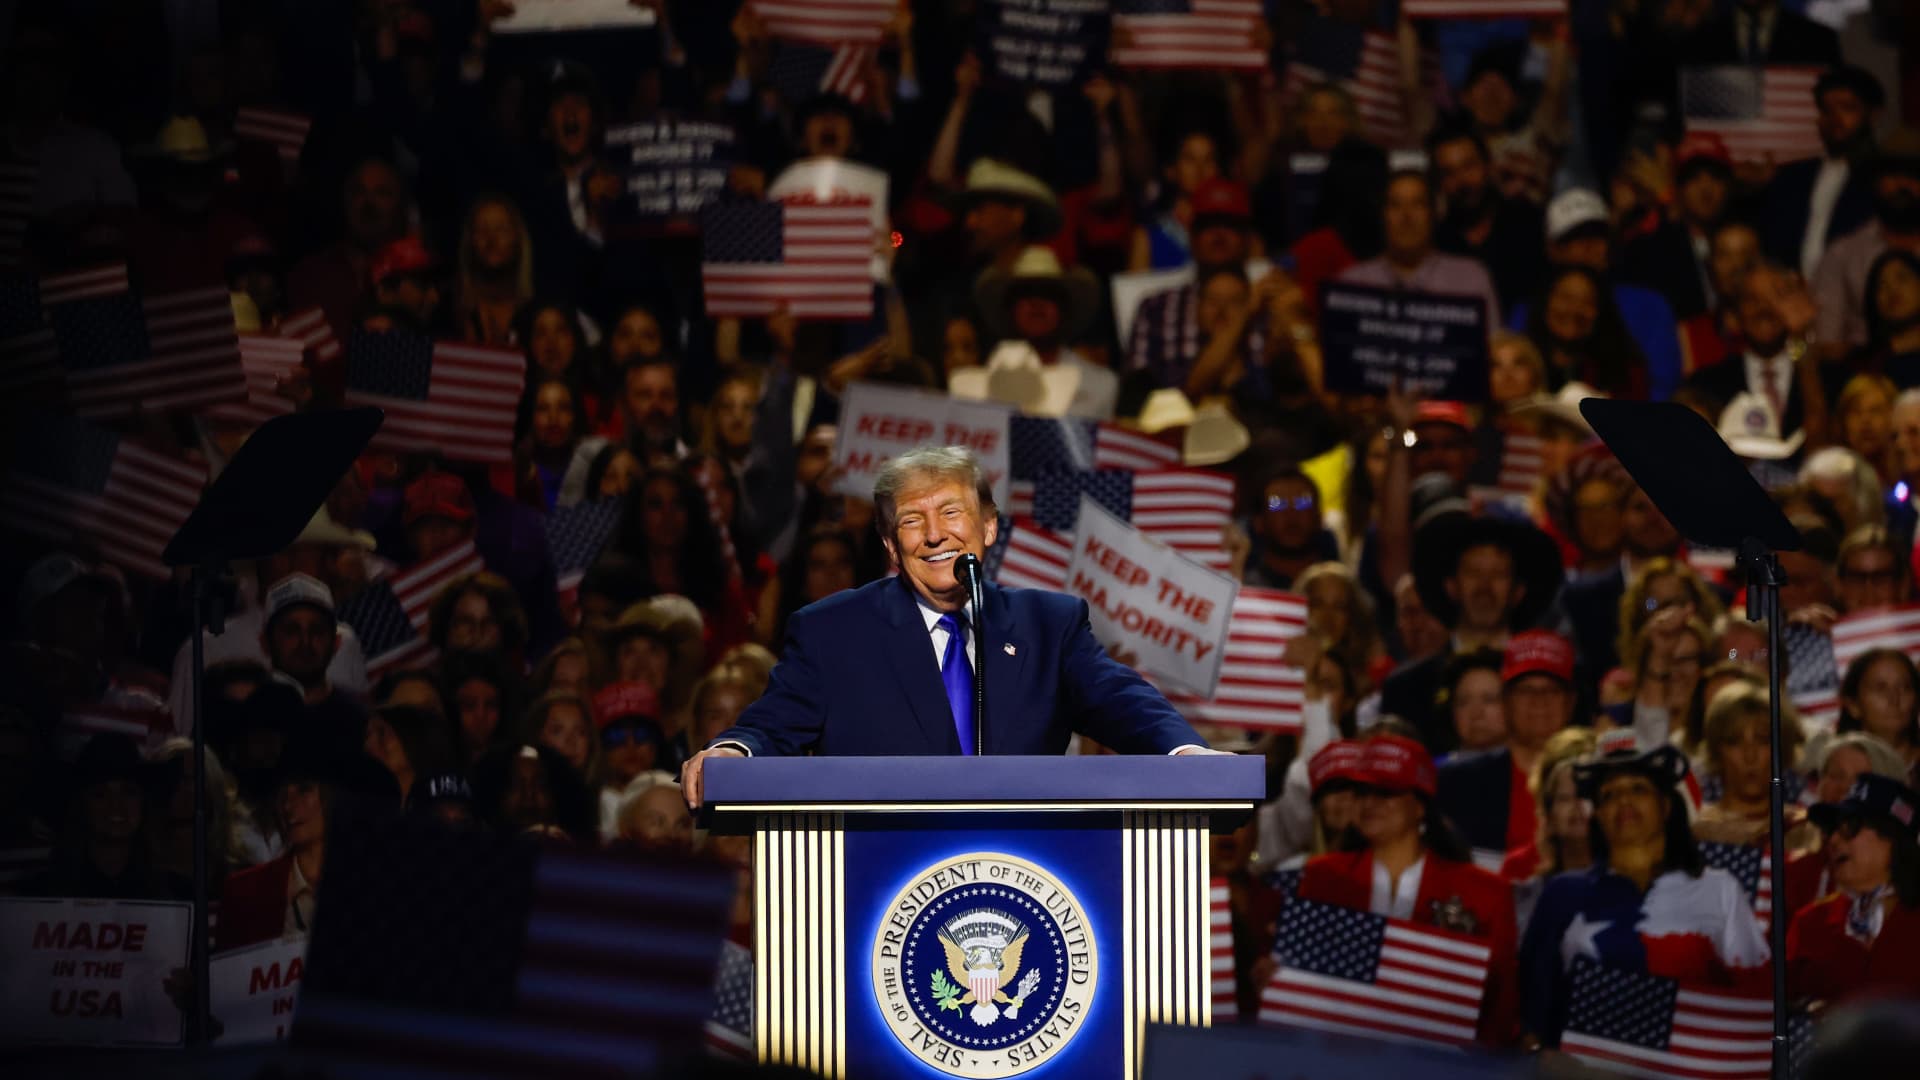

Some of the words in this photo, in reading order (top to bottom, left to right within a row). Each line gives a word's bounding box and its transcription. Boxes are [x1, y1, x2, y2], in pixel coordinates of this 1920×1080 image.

[857, 414, 934, 443] KEEP
[944, 424, 999, 453] THE
[1085, 534, 1150, 587] KEEP
[1157, 577, 1215, 623] THE
[1072, 571, 1214, 662] MAJORITY
[990, 865, 1011, 879] OF
[1015, 870, 1044, 894] THE
[881, 862, 981, 960] PRESIDENT
[32, 921, 147, 952] MADE
[1045, 890, 1089, 985] UNITED
[52, 960, 76, 977] IN
[82, 961, 125, 979] THE
[249, 957, 305, 994] MA
[883, 967, 898, 999] THE
[50, 989, 123, 1019] USA
[271, 996, 294, 1016] IN
[891, 1002, 908, 1022] OF
[909, 1022, 965, 1068] SEAL
[1007, 998, 1081, 1068] STATES
